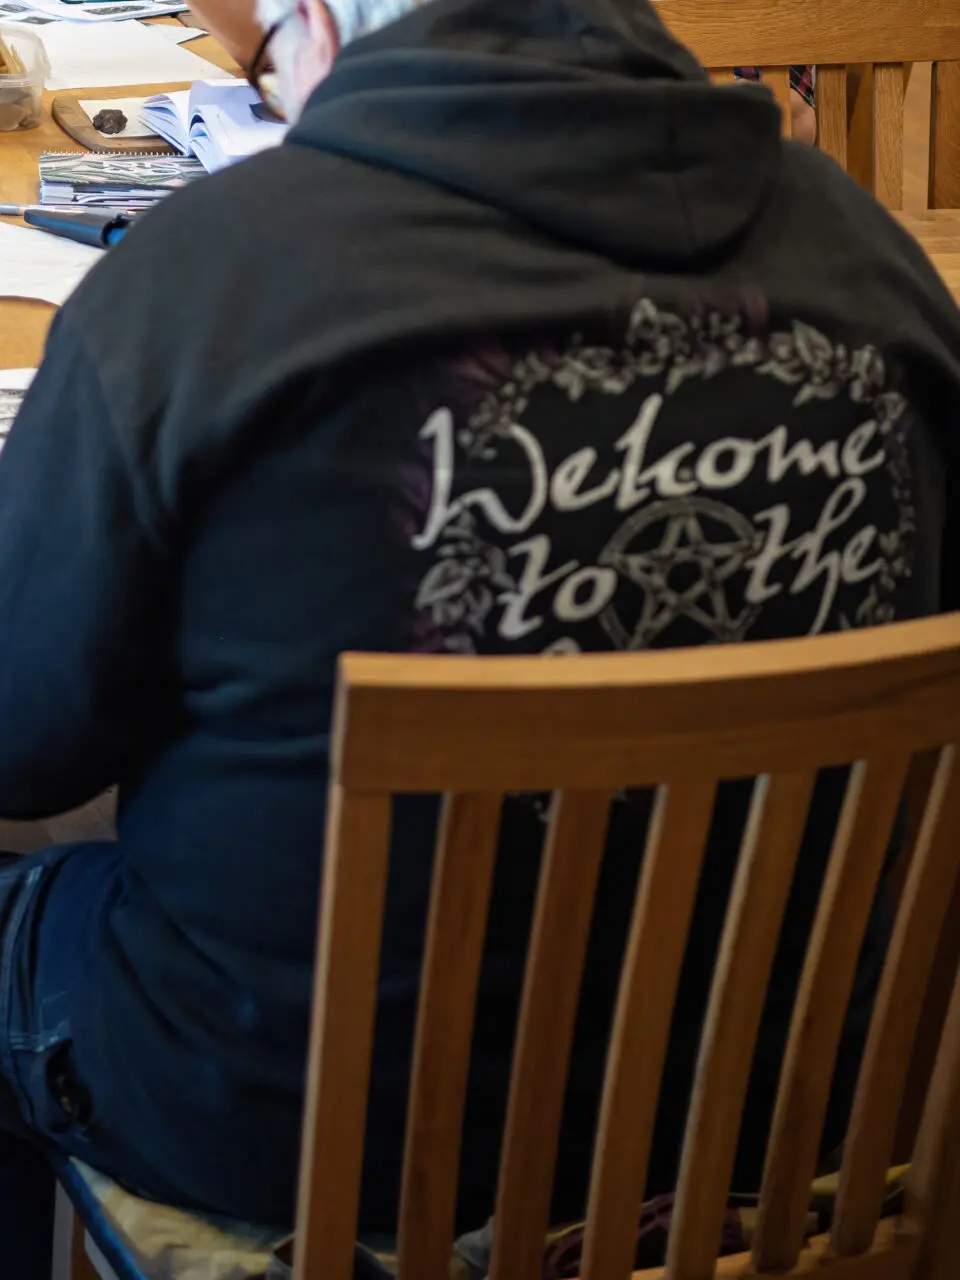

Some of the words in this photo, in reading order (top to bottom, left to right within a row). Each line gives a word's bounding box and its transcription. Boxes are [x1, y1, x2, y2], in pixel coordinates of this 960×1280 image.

[411, 394, 885, 549] Welcome
[497, 535, 619, 639] to
[745, 478, 884, 637] the
